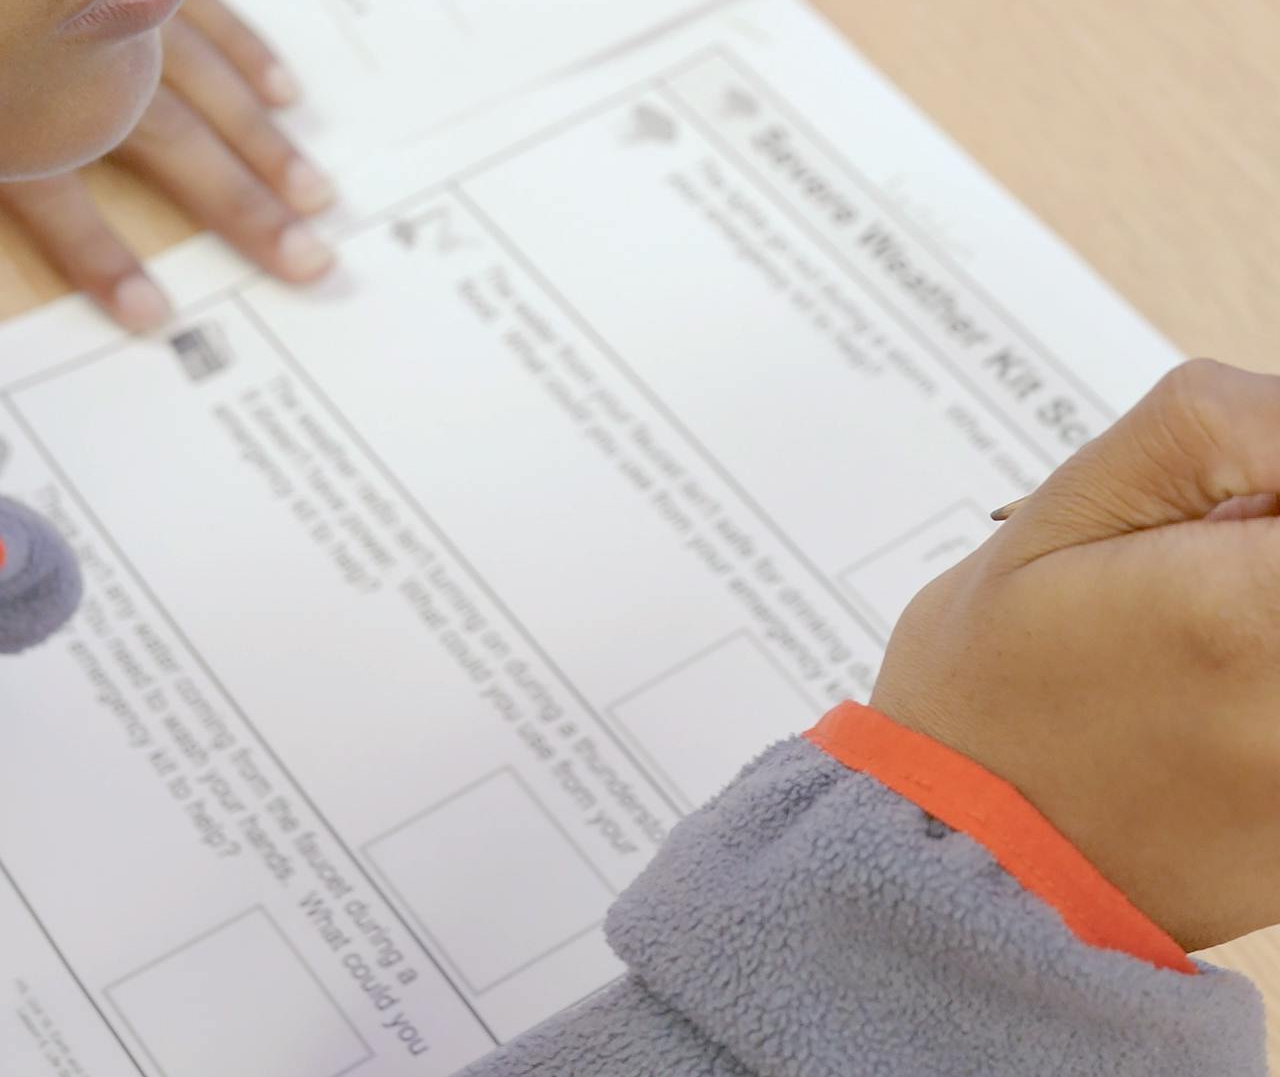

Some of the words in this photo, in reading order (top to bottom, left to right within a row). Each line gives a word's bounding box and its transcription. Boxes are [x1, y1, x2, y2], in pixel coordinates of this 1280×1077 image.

[857, 223, 992, 349] Weather
[983, 347, 1044, 402] Kit
[1035, 396, 1090, 454] Sc
[480, 674, 525, 724] you
[516, 722, 557, 762] use
[551, 759, 598, 812] from
[586, 809, 640, 855] your
[504, 659, 567, 726] during
[572, 738, 670, 845] thundersto
[846, 662, 880, 692] du
[148, 748, 179, 777] kit
[186, 799, 242, 858] help?
[173, 676, 238, 751] coming
[229, 748, 272, 796] from
[264, 796, 300, 834] the
[293, 831, 355, 900] faucet
[344, 900, 405, 970] during
[199, 768, 248, 815] your
[238, 814, 296, 888] hands.
[299, 891, 352, 952] What
[342, 953, 402, 1014] could
[382, 1012, 429, 1057] you
